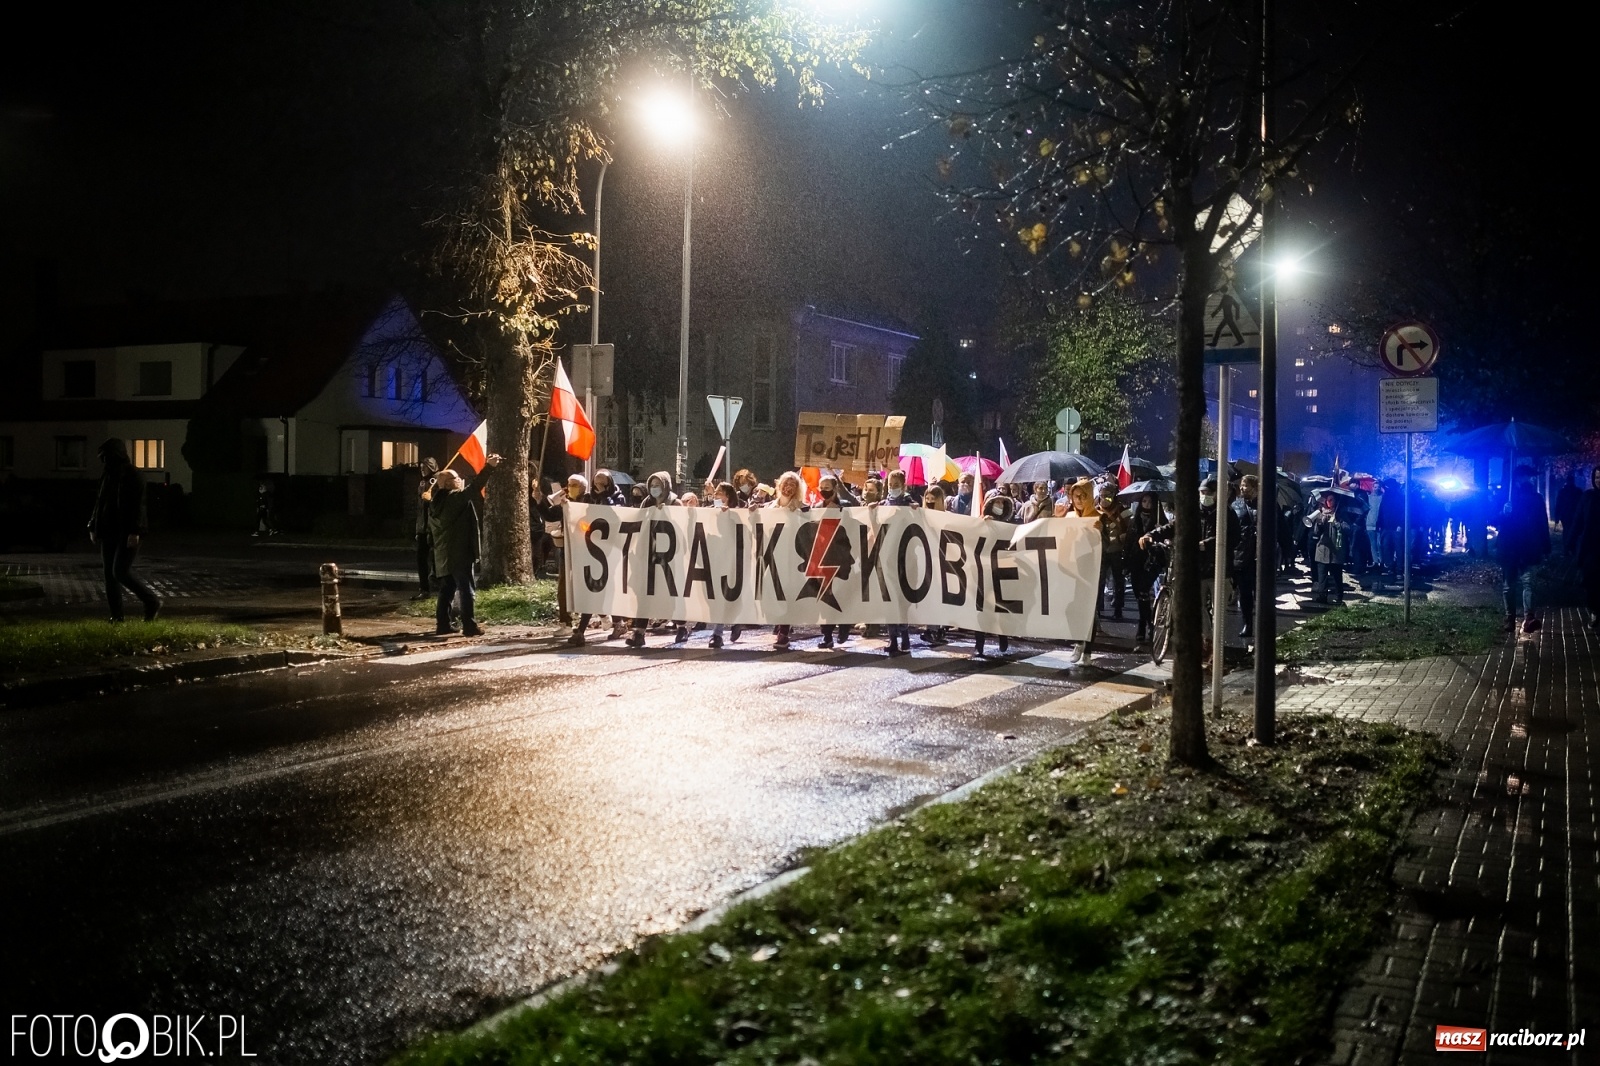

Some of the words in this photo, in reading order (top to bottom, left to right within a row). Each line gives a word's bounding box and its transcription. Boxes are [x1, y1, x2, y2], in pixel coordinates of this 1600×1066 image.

[798, 424, 824, 467] To
[826, 427, 868, 460] jest
[584, 517, 786, 603] STRAJK
[861, 522, 1058, 616] KOBIET
